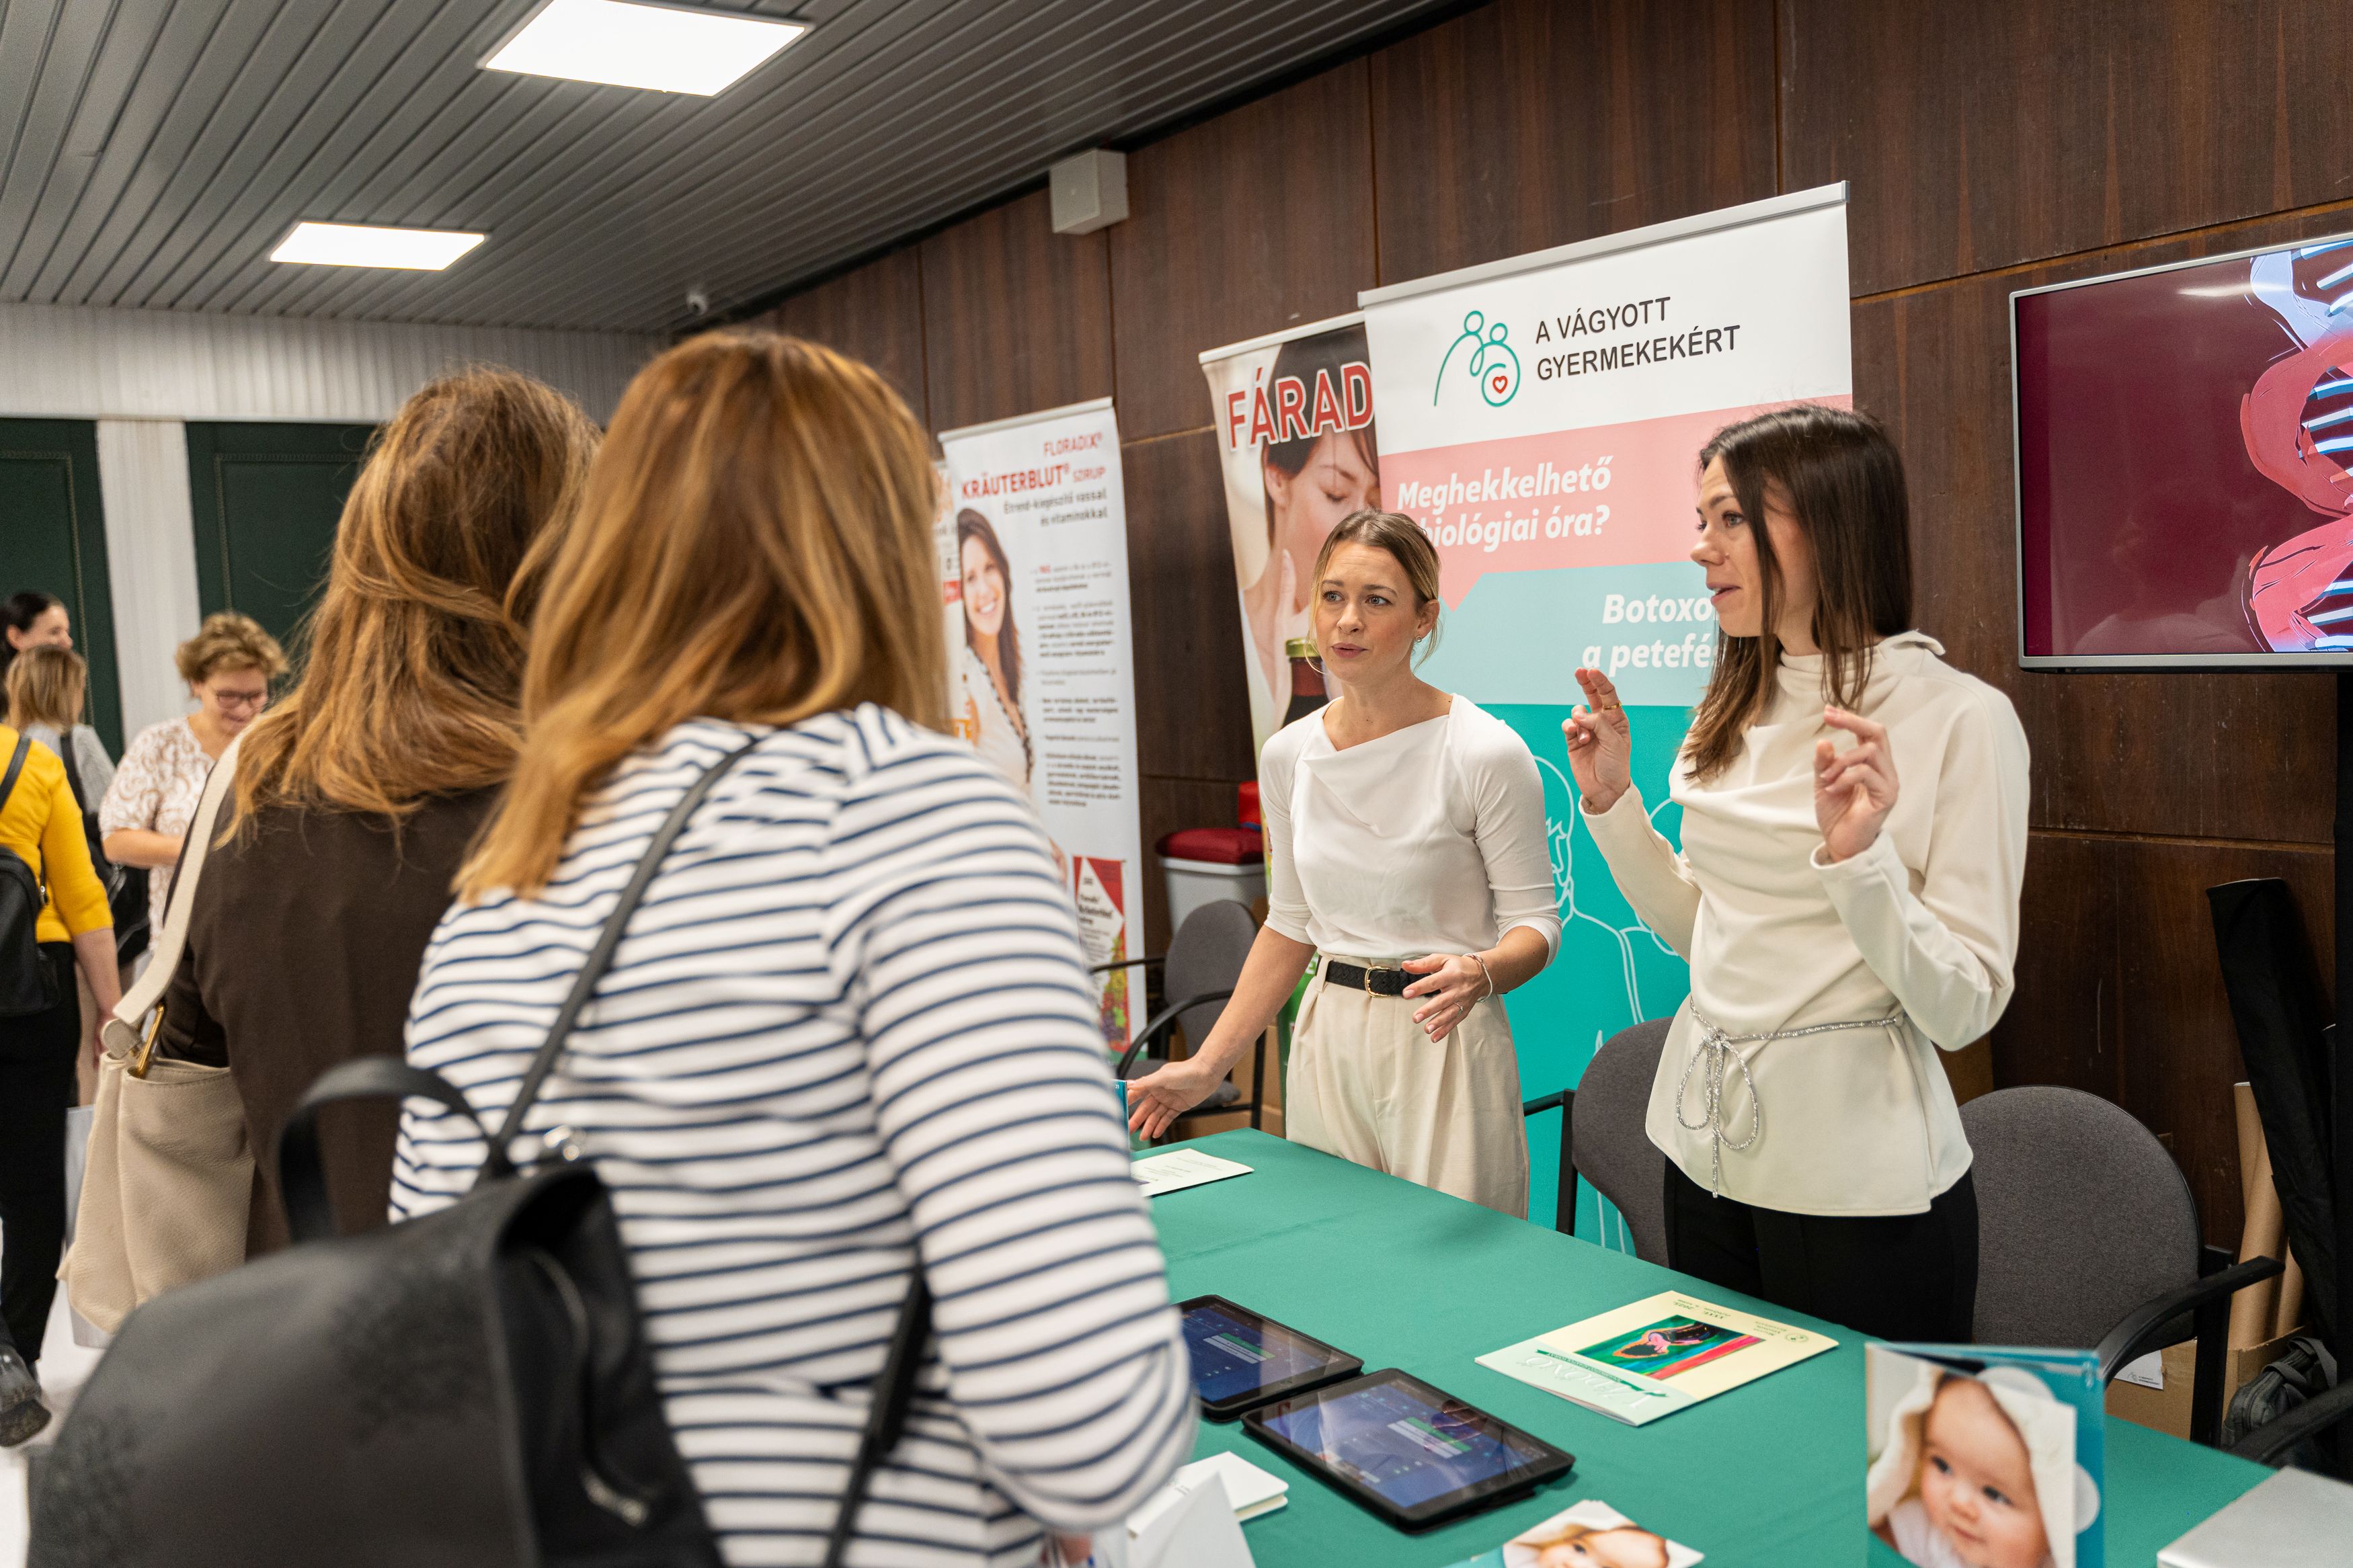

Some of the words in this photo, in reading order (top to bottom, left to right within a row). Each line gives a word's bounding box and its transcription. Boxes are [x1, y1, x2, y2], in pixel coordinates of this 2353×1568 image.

[1536, 320, 1550, 344] A
[1557, 296, 1671, 339] VÁGYOTT
[1537, 324, 1741, 380] GYERMEKEKÉRT
[1397, 455, 1613, 515] Meghekkelhető
[1545, 505, 1610, 539] óra?
[1602, 594, 1719, 624] Botoxo
[1582, 645, 1601, 669] a
[1609, 632, 1719, 677] petefé
